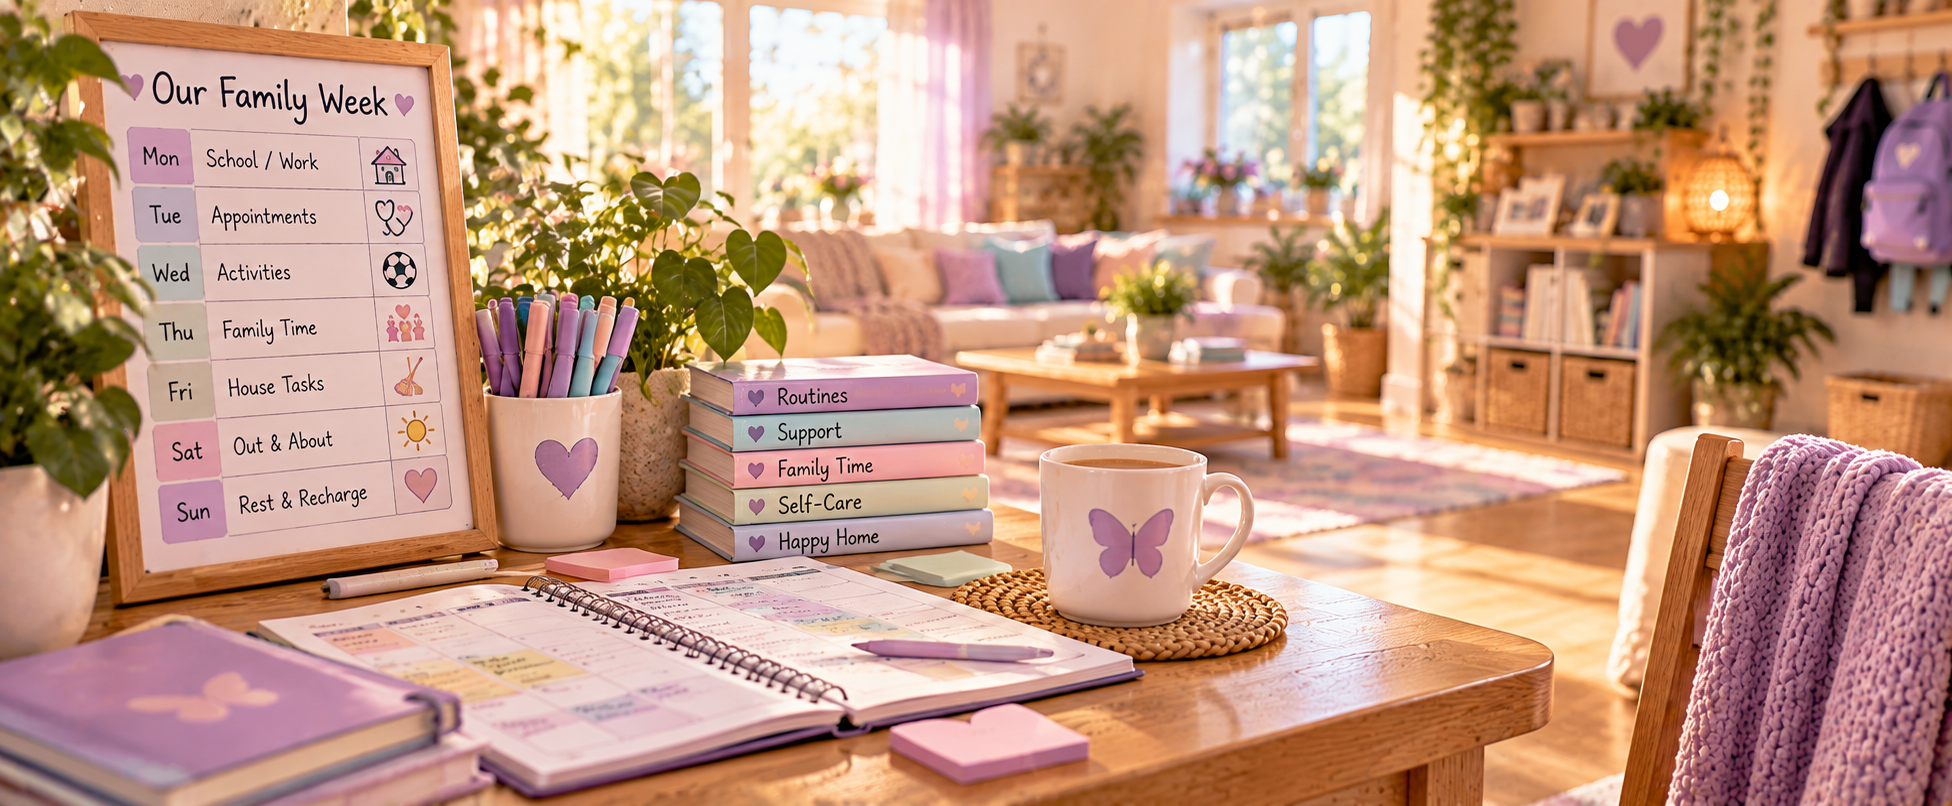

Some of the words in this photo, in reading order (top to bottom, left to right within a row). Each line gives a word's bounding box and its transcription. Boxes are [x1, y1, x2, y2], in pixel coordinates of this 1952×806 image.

[153, 71, 207, 105] Our
[220, 76, 307, 125] Family
[318, 83, 388, 116] Week
[143, 146, 179, 166] Mon
[207, 149, 258, 168] School
[265, 151, 272, 170] /
[279, 152, 318, 170] Work
[149, 205, 181, 224] Tue
[212, 206, 316, 231] Appointments
[152, 263, 190, 282] Wed
[218, 263, 290, 281] Activities
[159, 321, 193, 341] Thu
[223, 319, 274, 345] Family
[280, 319, 317, 336] Time
[169, 381, 192, 402] Fri
[228, 378, 275, 397] House
[281, 374, 324, 393] Tasks
[778, 388, 847, 406] Routines
[234, 437, 263, 455] Out
[271, 434, 281, 452] &
[289, 431, 333, 450] About
[778, 422, 842, 446] Support
[172, 442, 203, 461] Sat
[779, 459, 829, 482] Family
[836, 457, 873, 474] Time
[239, 494, 274, 514] Rest
[282, 491, 292, 509] &
[299, 486, 367, 507] Recharge
[778, 494, 862, 515] Self-Care
[177, 502, 210, 522] Sun
[779, 532, 829, 554] Happy
[837, 528, 879, 546] Home
